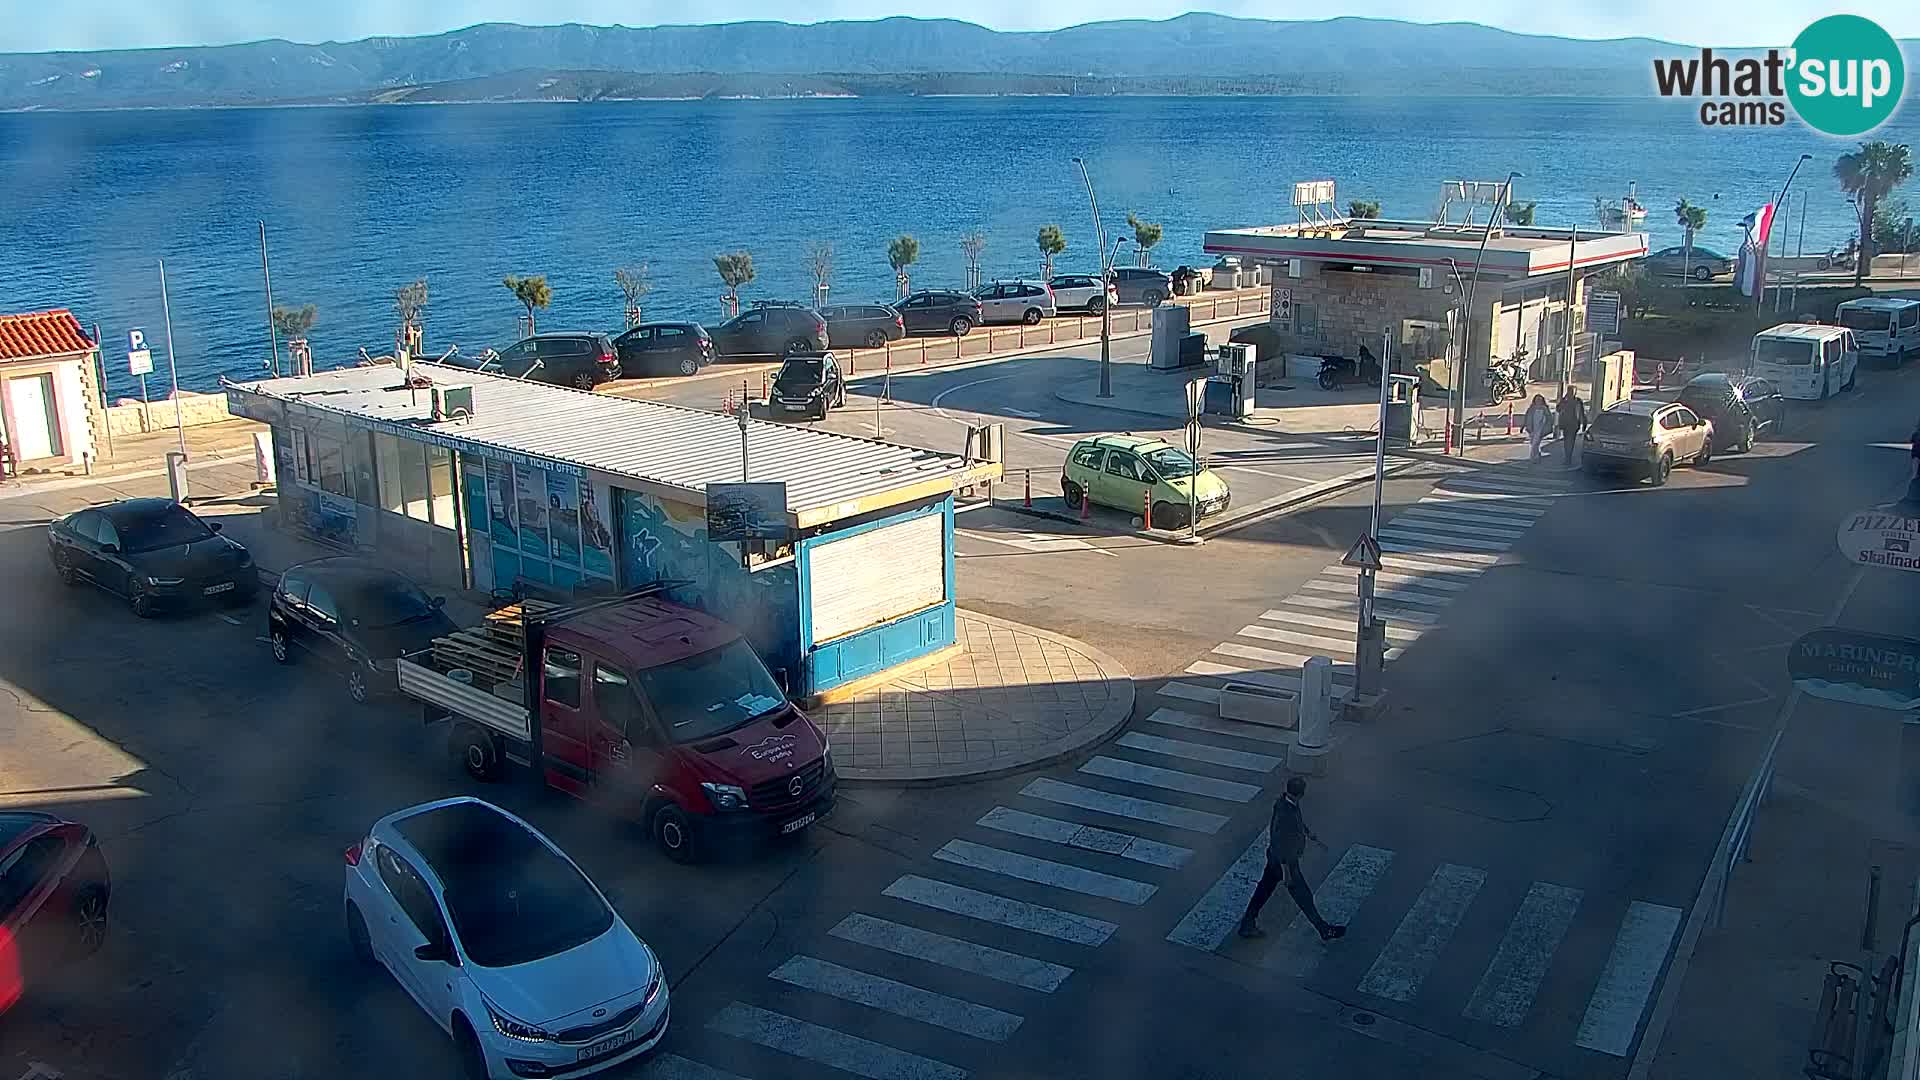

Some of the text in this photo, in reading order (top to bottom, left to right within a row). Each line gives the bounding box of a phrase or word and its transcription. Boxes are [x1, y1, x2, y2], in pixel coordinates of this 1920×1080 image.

[130, 331, 144, 350] P
[479, 446, 494, 458] BUS
[495, 449, 527, 465] STATION
[529, 457, 555, 472] TICKET
[556, 463, 583, 478] OFFICE
[1848, 515, 1920, 534] PIZZE
[1870, 666, 1896, 682] bar
